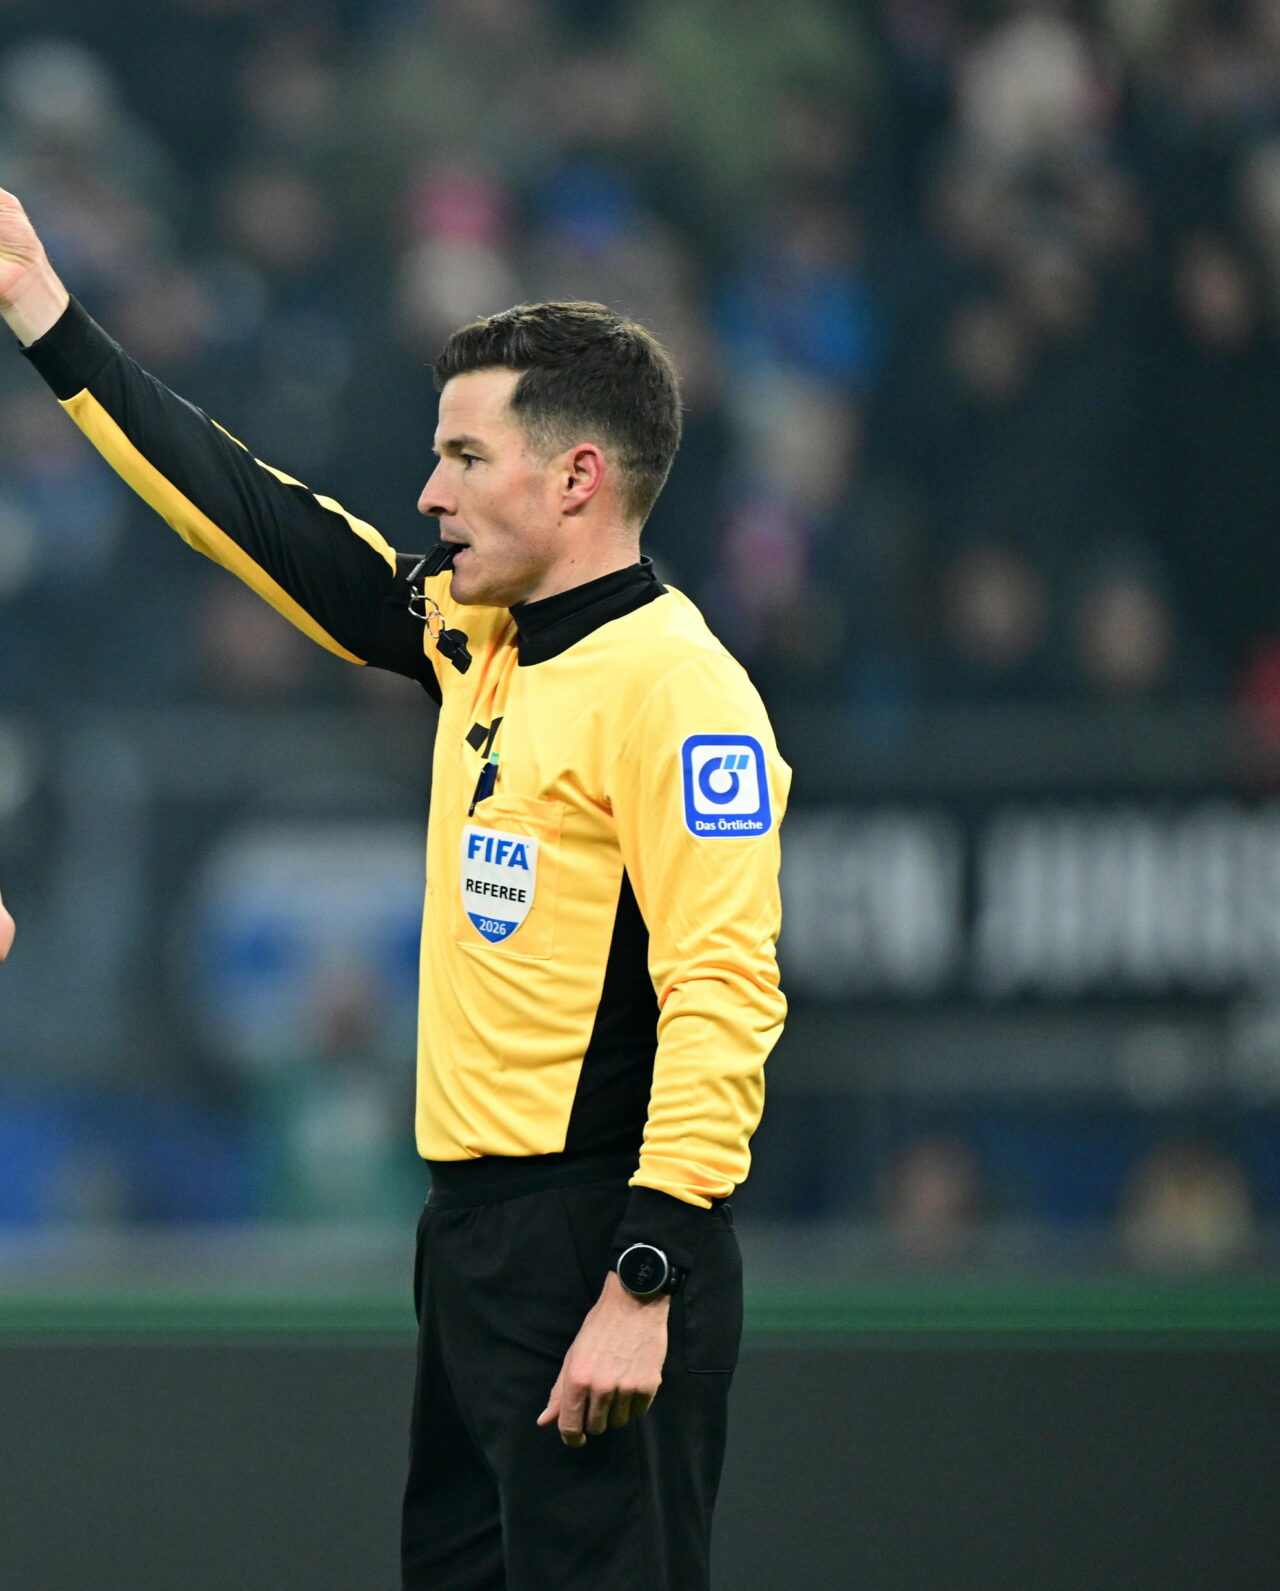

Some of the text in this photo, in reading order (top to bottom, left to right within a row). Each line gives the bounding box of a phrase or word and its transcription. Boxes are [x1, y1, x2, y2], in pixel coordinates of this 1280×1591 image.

[695, 818, 763, 831] Das Örtliche
[467, 833, 529, 871] FIFA
[466, 878, 527, 903] REFEREE
[479, 919, 507, 935] 2026
